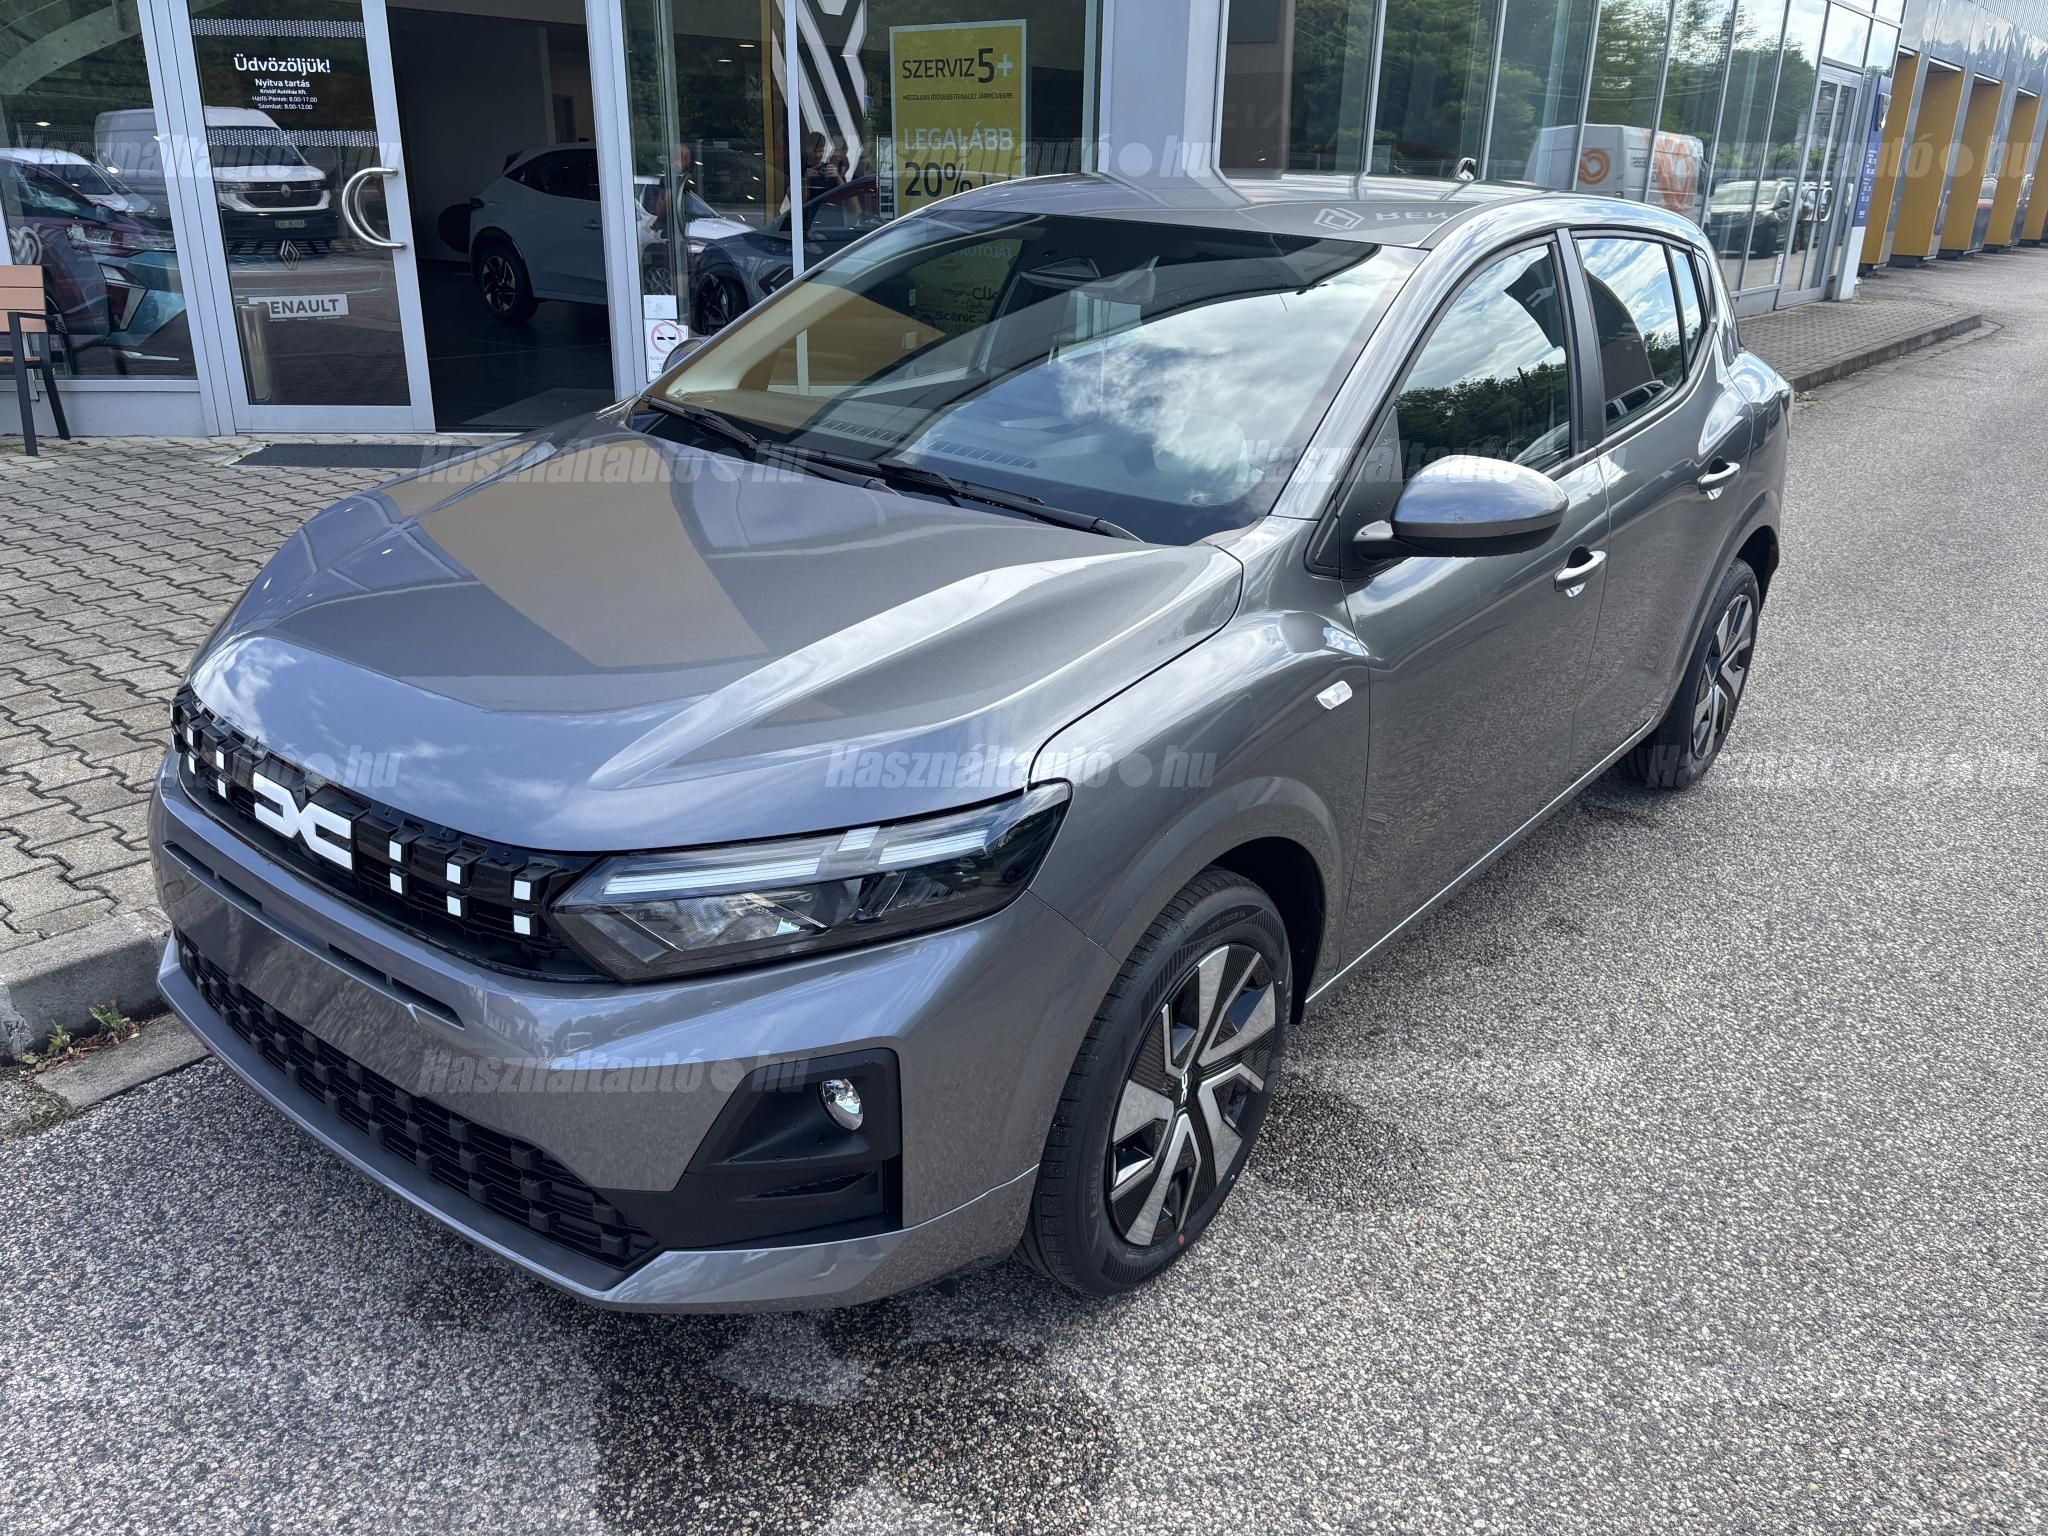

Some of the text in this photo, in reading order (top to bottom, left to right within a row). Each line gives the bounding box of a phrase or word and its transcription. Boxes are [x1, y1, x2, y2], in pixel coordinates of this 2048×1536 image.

[234, 53, 331, 76] Üdvözöljük!
[902, 57, 975, 79] SZERVIZ
[255, 78, 310, 88] Nyitva tartás
[903, 121, 1014, 151] LEGALÁBB
[904, 162, 973, 197] 20%
[261, 299, 339, 315] ENAULT
